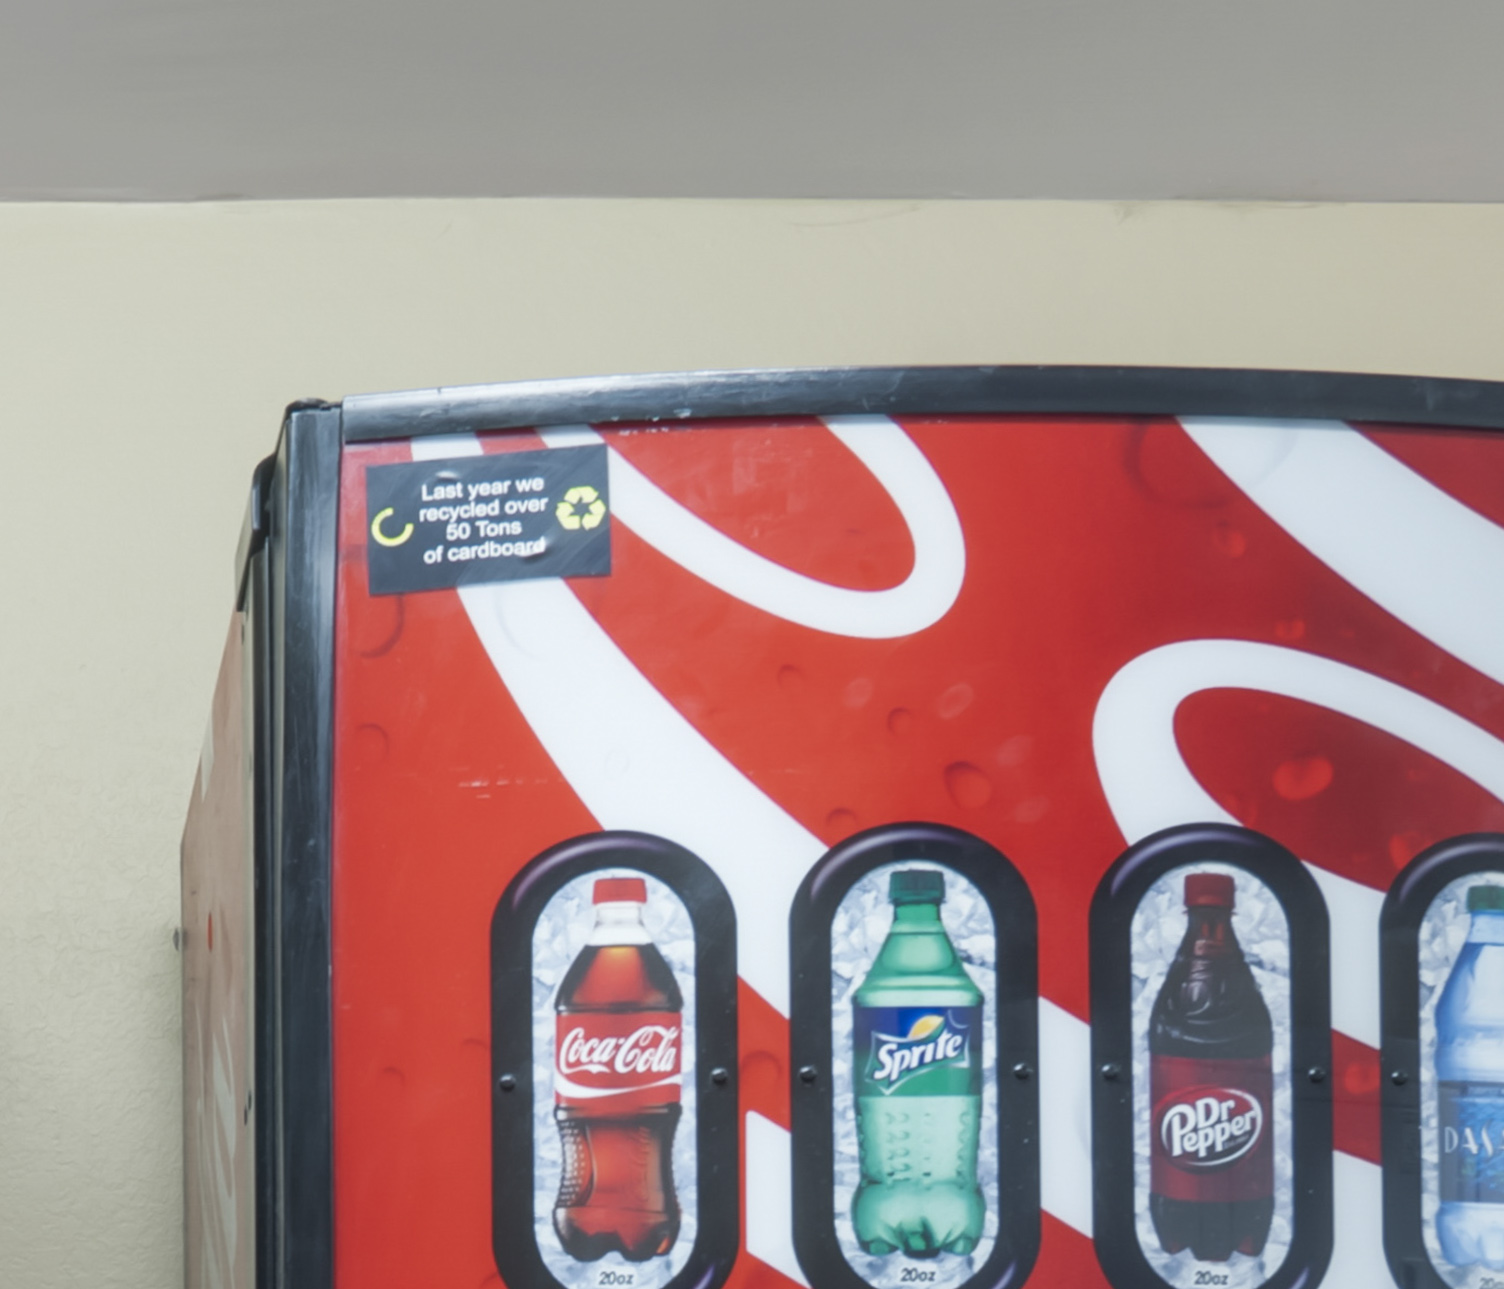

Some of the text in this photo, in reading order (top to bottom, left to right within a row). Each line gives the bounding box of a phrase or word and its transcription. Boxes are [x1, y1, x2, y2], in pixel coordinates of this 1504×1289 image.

[422, 476, 544, 501] Last year we
[419, 497, 548, 522] recycled over
[446, 520, 522, 541] 50 Tons
[423, 537, 547, 564] of cardboard
[559, 1025, 682, 1075] Coca-Cola
[873, 1031, 964, 1083] Sprite
[1192, 1097, 1235, 1124] Dr
[1169, 1105, 1259, 1159] Pepper
[598, 1271, 634, 1287] 20oz
[900, 1268, 935, 1284] 20oz
[1194, 1270, 1228, 1287] 20oz
